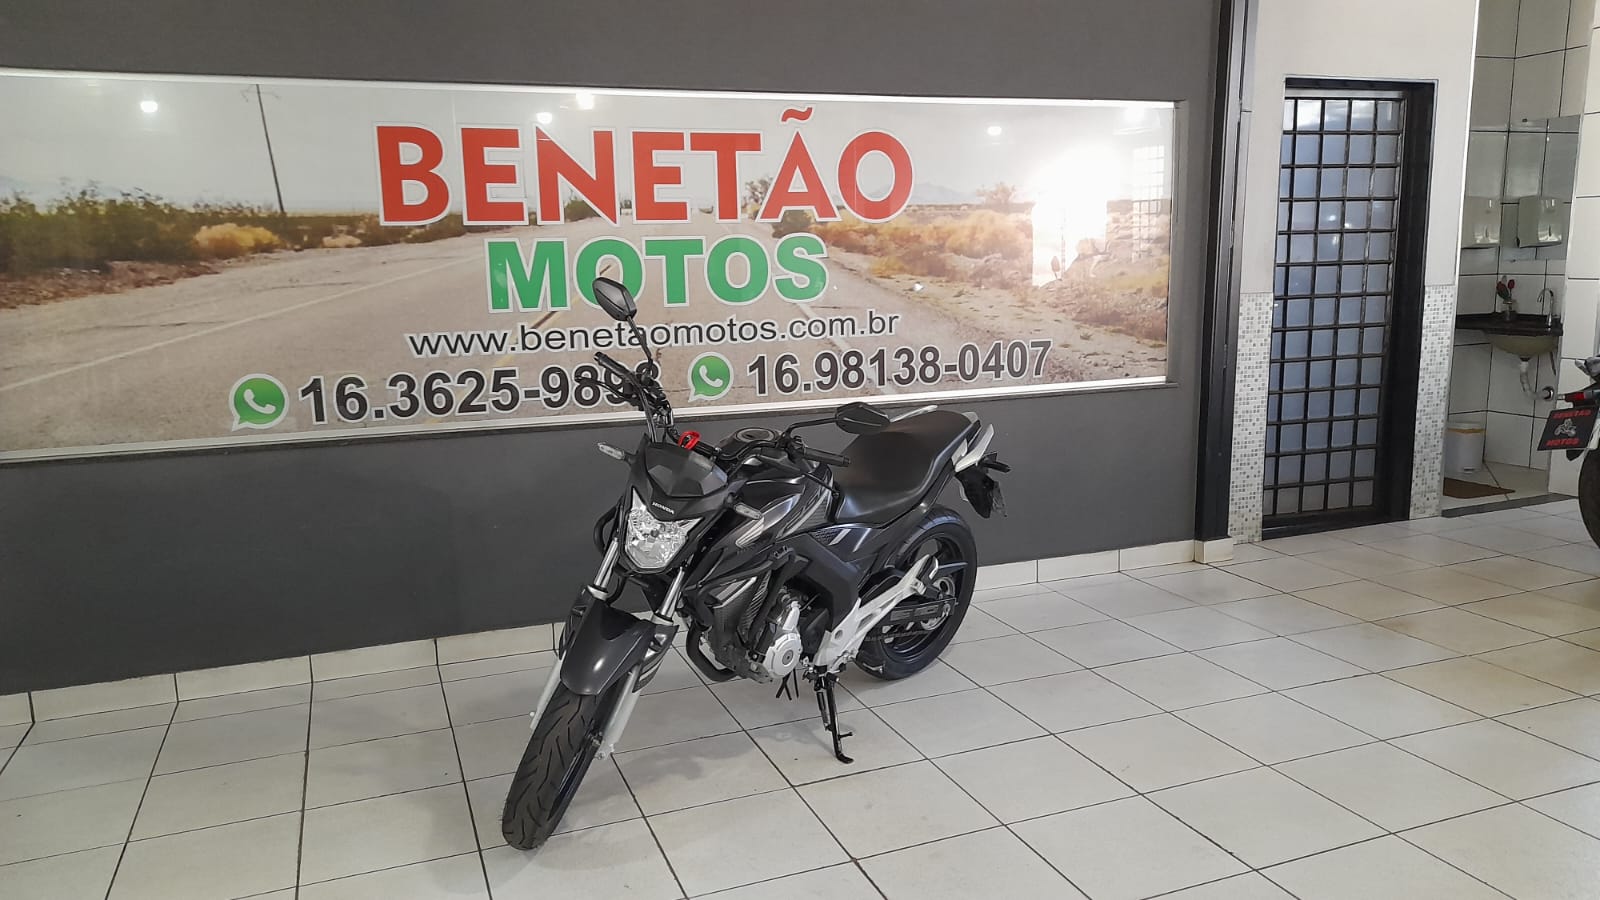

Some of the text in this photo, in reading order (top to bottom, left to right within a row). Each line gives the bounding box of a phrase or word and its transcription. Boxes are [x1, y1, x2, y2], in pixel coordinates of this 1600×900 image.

[376, 106, 913, 225] BENETÃO
[487, 234, 829, 312] MOTOS
[409, 311, 899, 356] www.benetaomotos.com.br
[747, 341, 1053, 396] 16.98138-0407
[652, 501, 675, 515] HONDA
